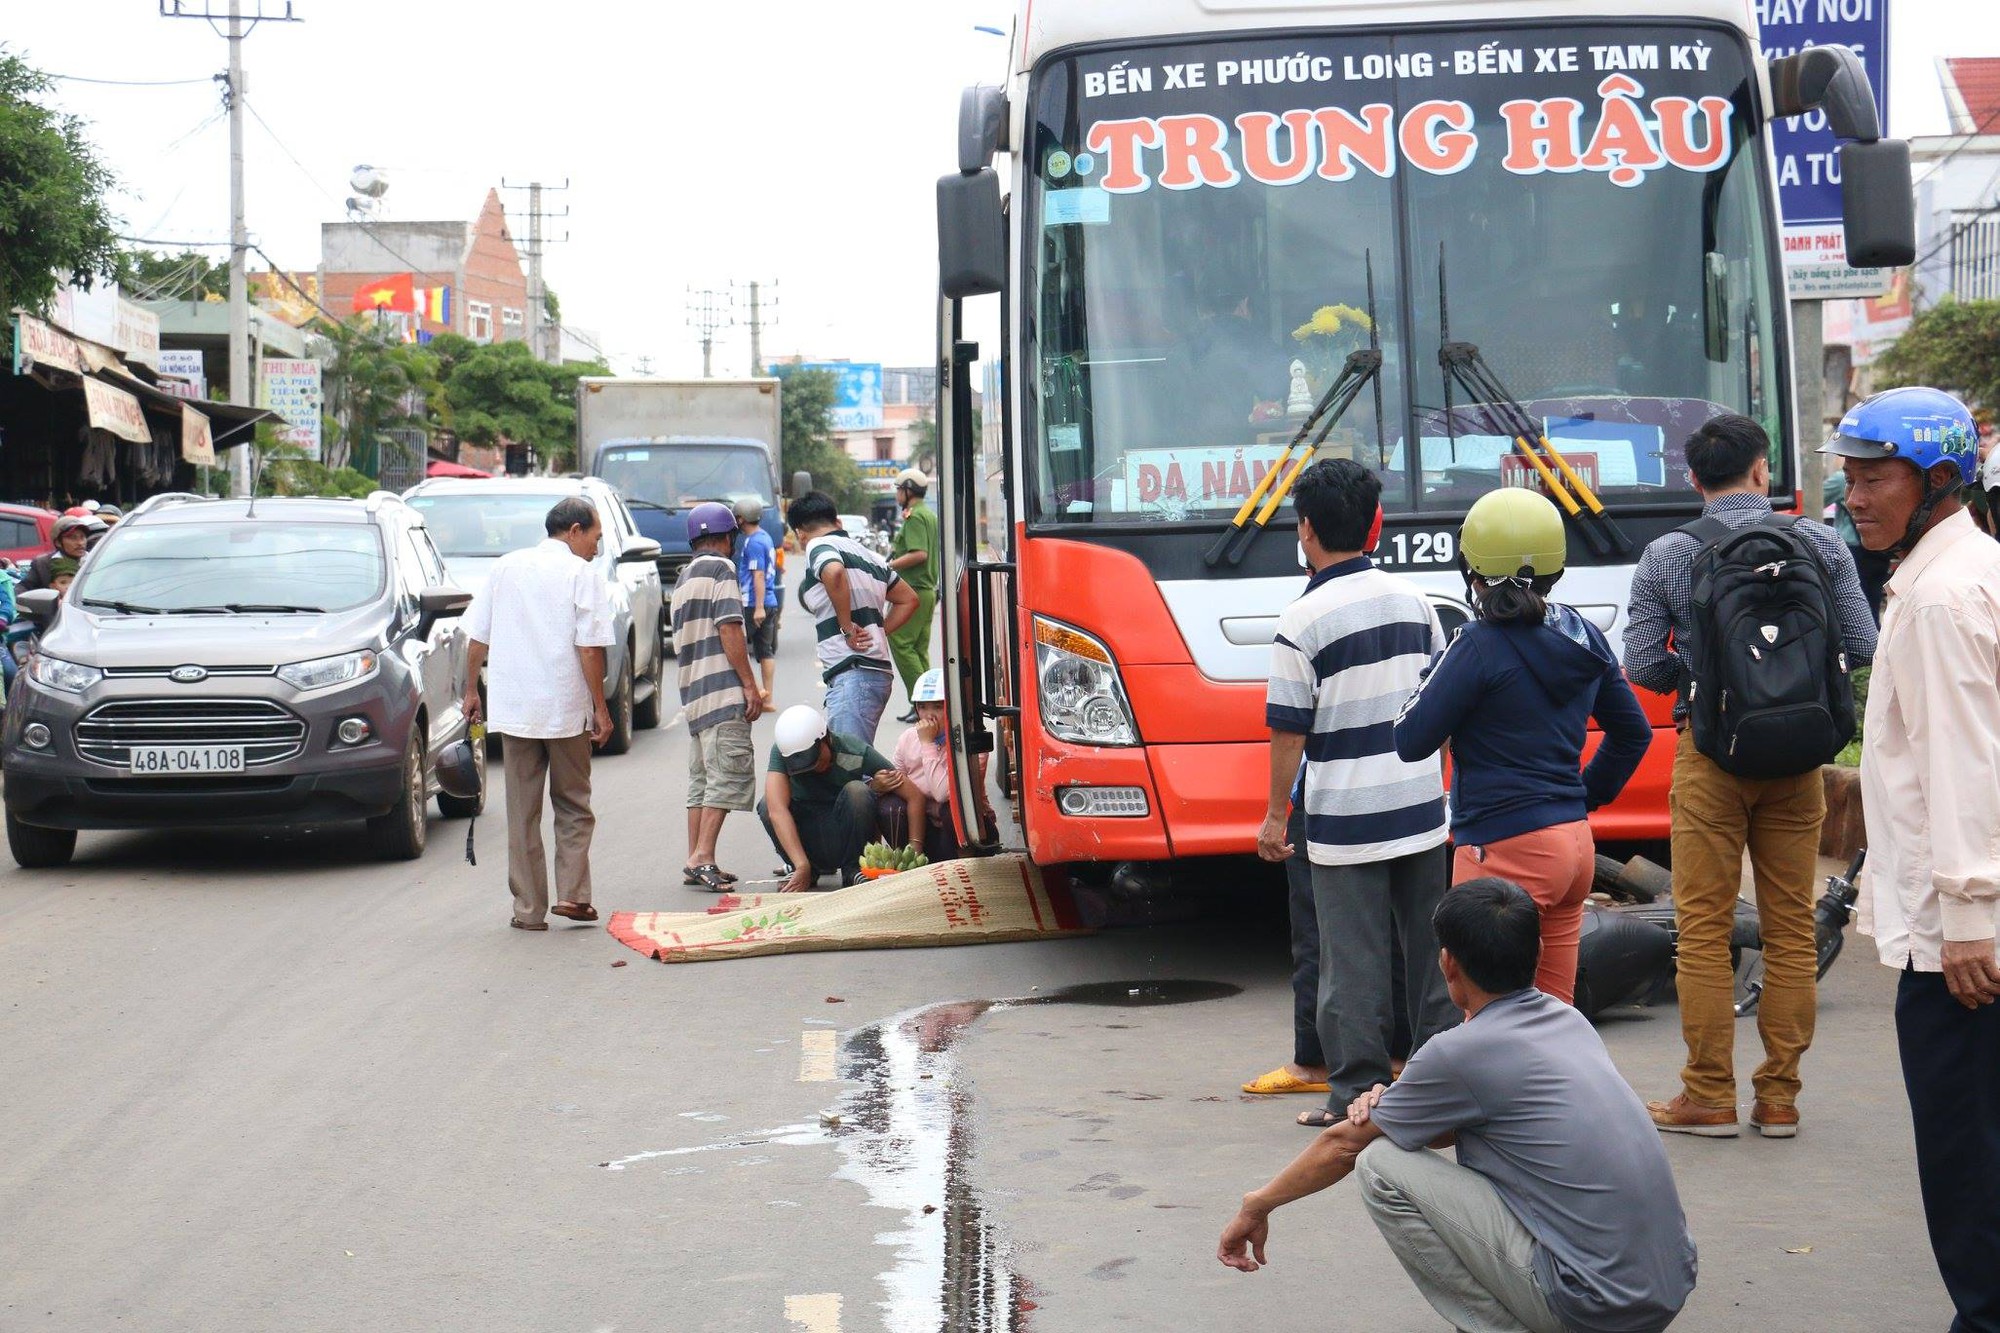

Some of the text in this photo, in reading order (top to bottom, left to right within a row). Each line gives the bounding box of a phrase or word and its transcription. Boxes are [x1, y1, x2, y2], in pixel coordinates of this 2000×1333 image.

[1085, 60, 1152, 97] BẾN
[1163, 63, 1206, 90] XE
[1217, 52, 1332, 86] PHƯỚC
[1344, 53, 1433, 80] LONG
[1454, 41, 1523, 75] BẾN
[1534, 47, 1579, 72] XE
[1588, 45, 1658, 70] TAM
[1670, 39, 1712, 71] KỲ
[1086, 73, 1734, 194] TRUNG HẬU
[1137, 453, 1187, 502] ĐÀ
[135, 749, 240, 771] 48A-041.08
